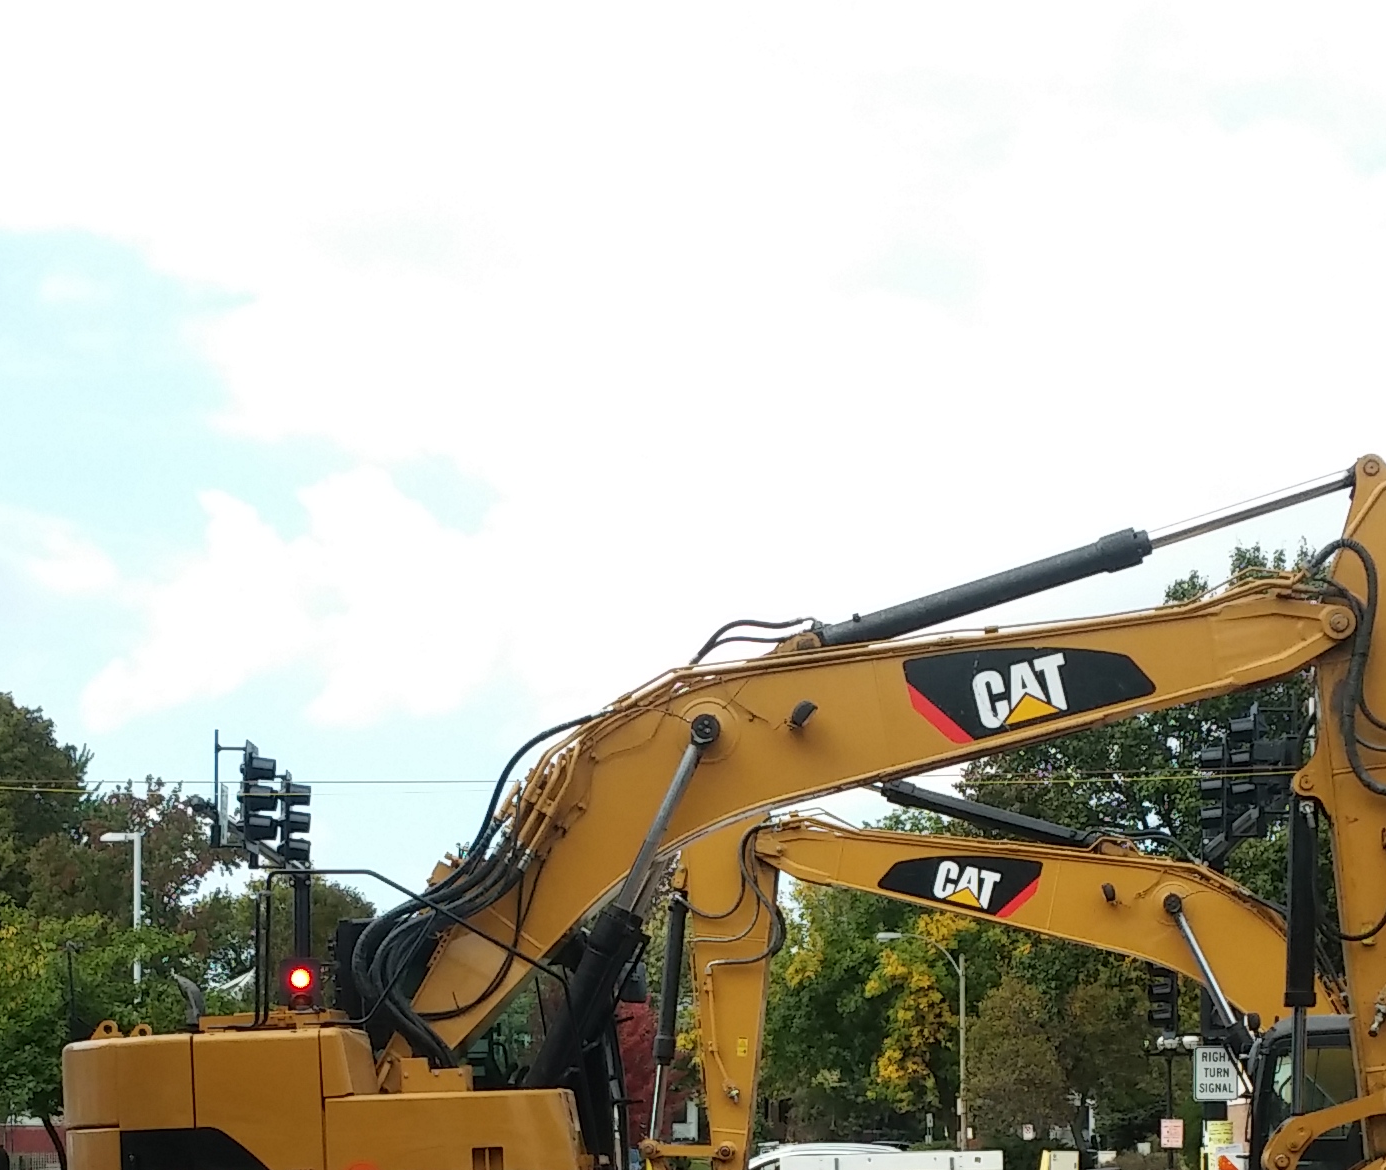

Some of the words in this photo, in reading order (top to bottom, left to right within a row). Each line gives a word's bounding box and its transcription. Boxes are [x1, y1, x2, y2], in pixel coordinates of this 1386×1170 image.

[972, 652, 1068, 729] CAT
[933, 860, 1002, 909] CAT
[1201, 1051, 1231, 1062] RIGH
[1203, 1067, 1230, 1078] TURN
[1198, 1082, 1234, 1093] SIGNAL
